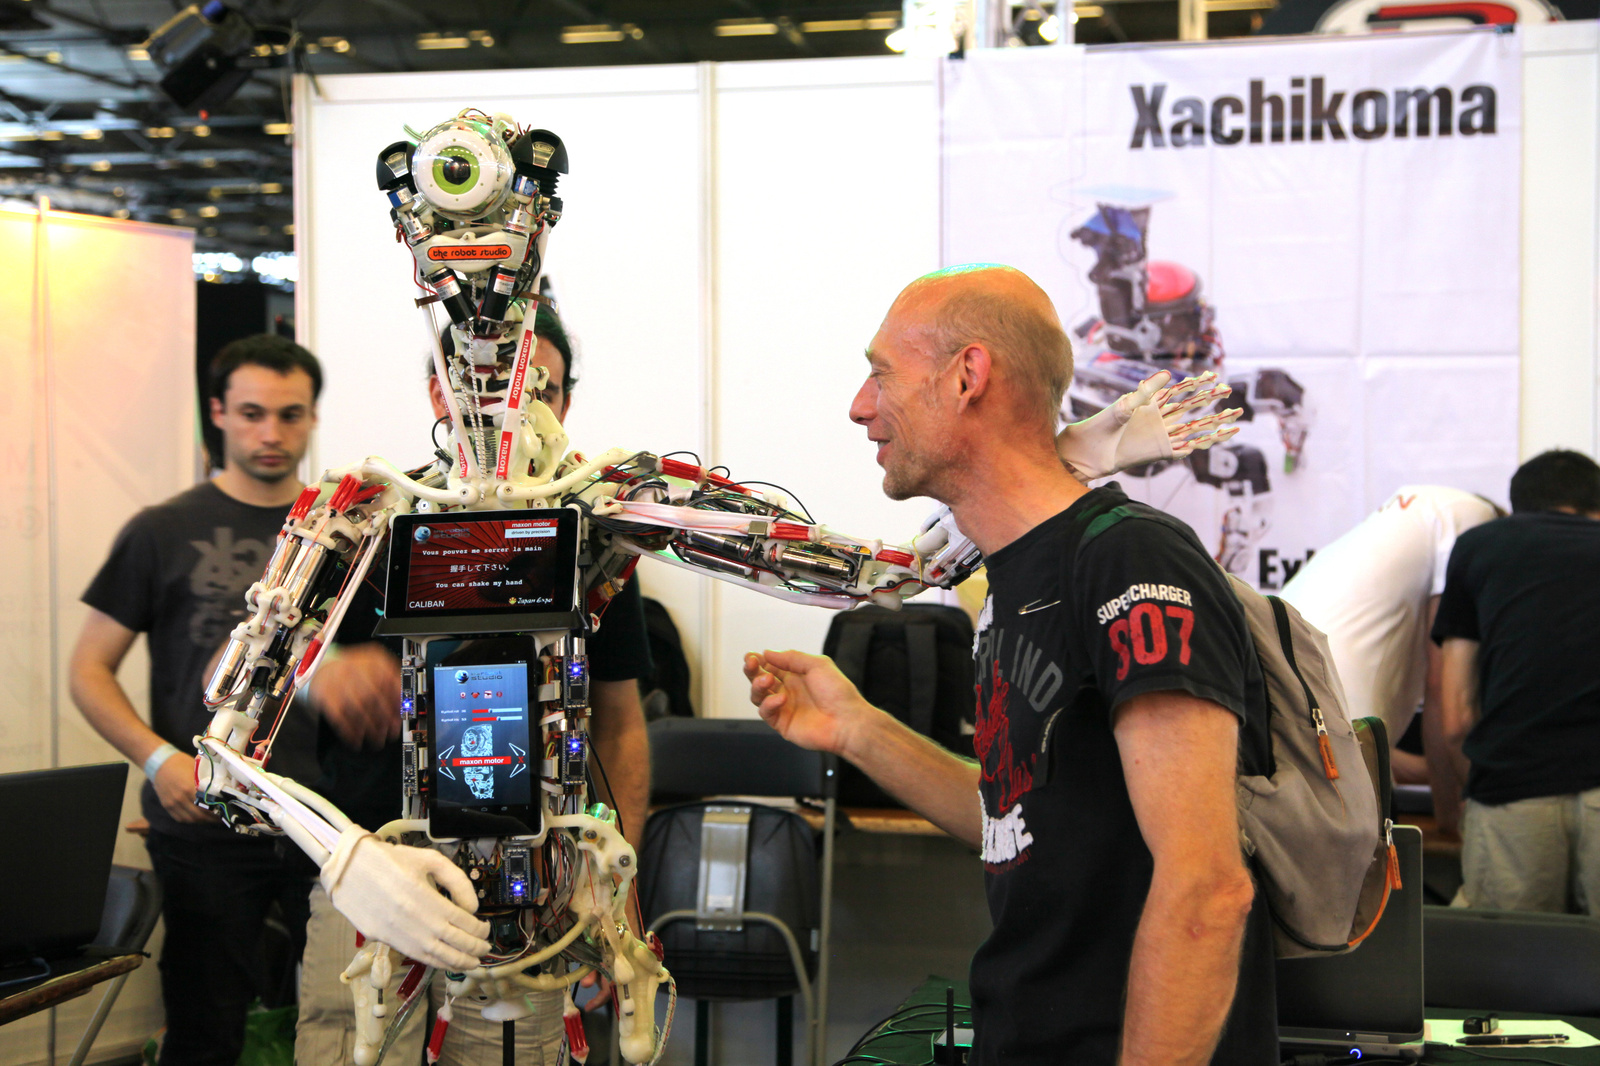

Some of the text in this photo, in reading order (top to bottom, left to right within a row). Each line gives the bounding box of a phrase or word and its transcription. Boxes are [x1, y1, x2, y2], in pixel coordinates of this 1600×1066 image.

[1129, 75, 1498, 149] Xachikoma
[433, 247, 508, 259] the robot studio
[512, 338, 530, 400] maxon motor
[498, 440, 509, 473] maxon
[408, 600, 445, 609] CALIBAN
